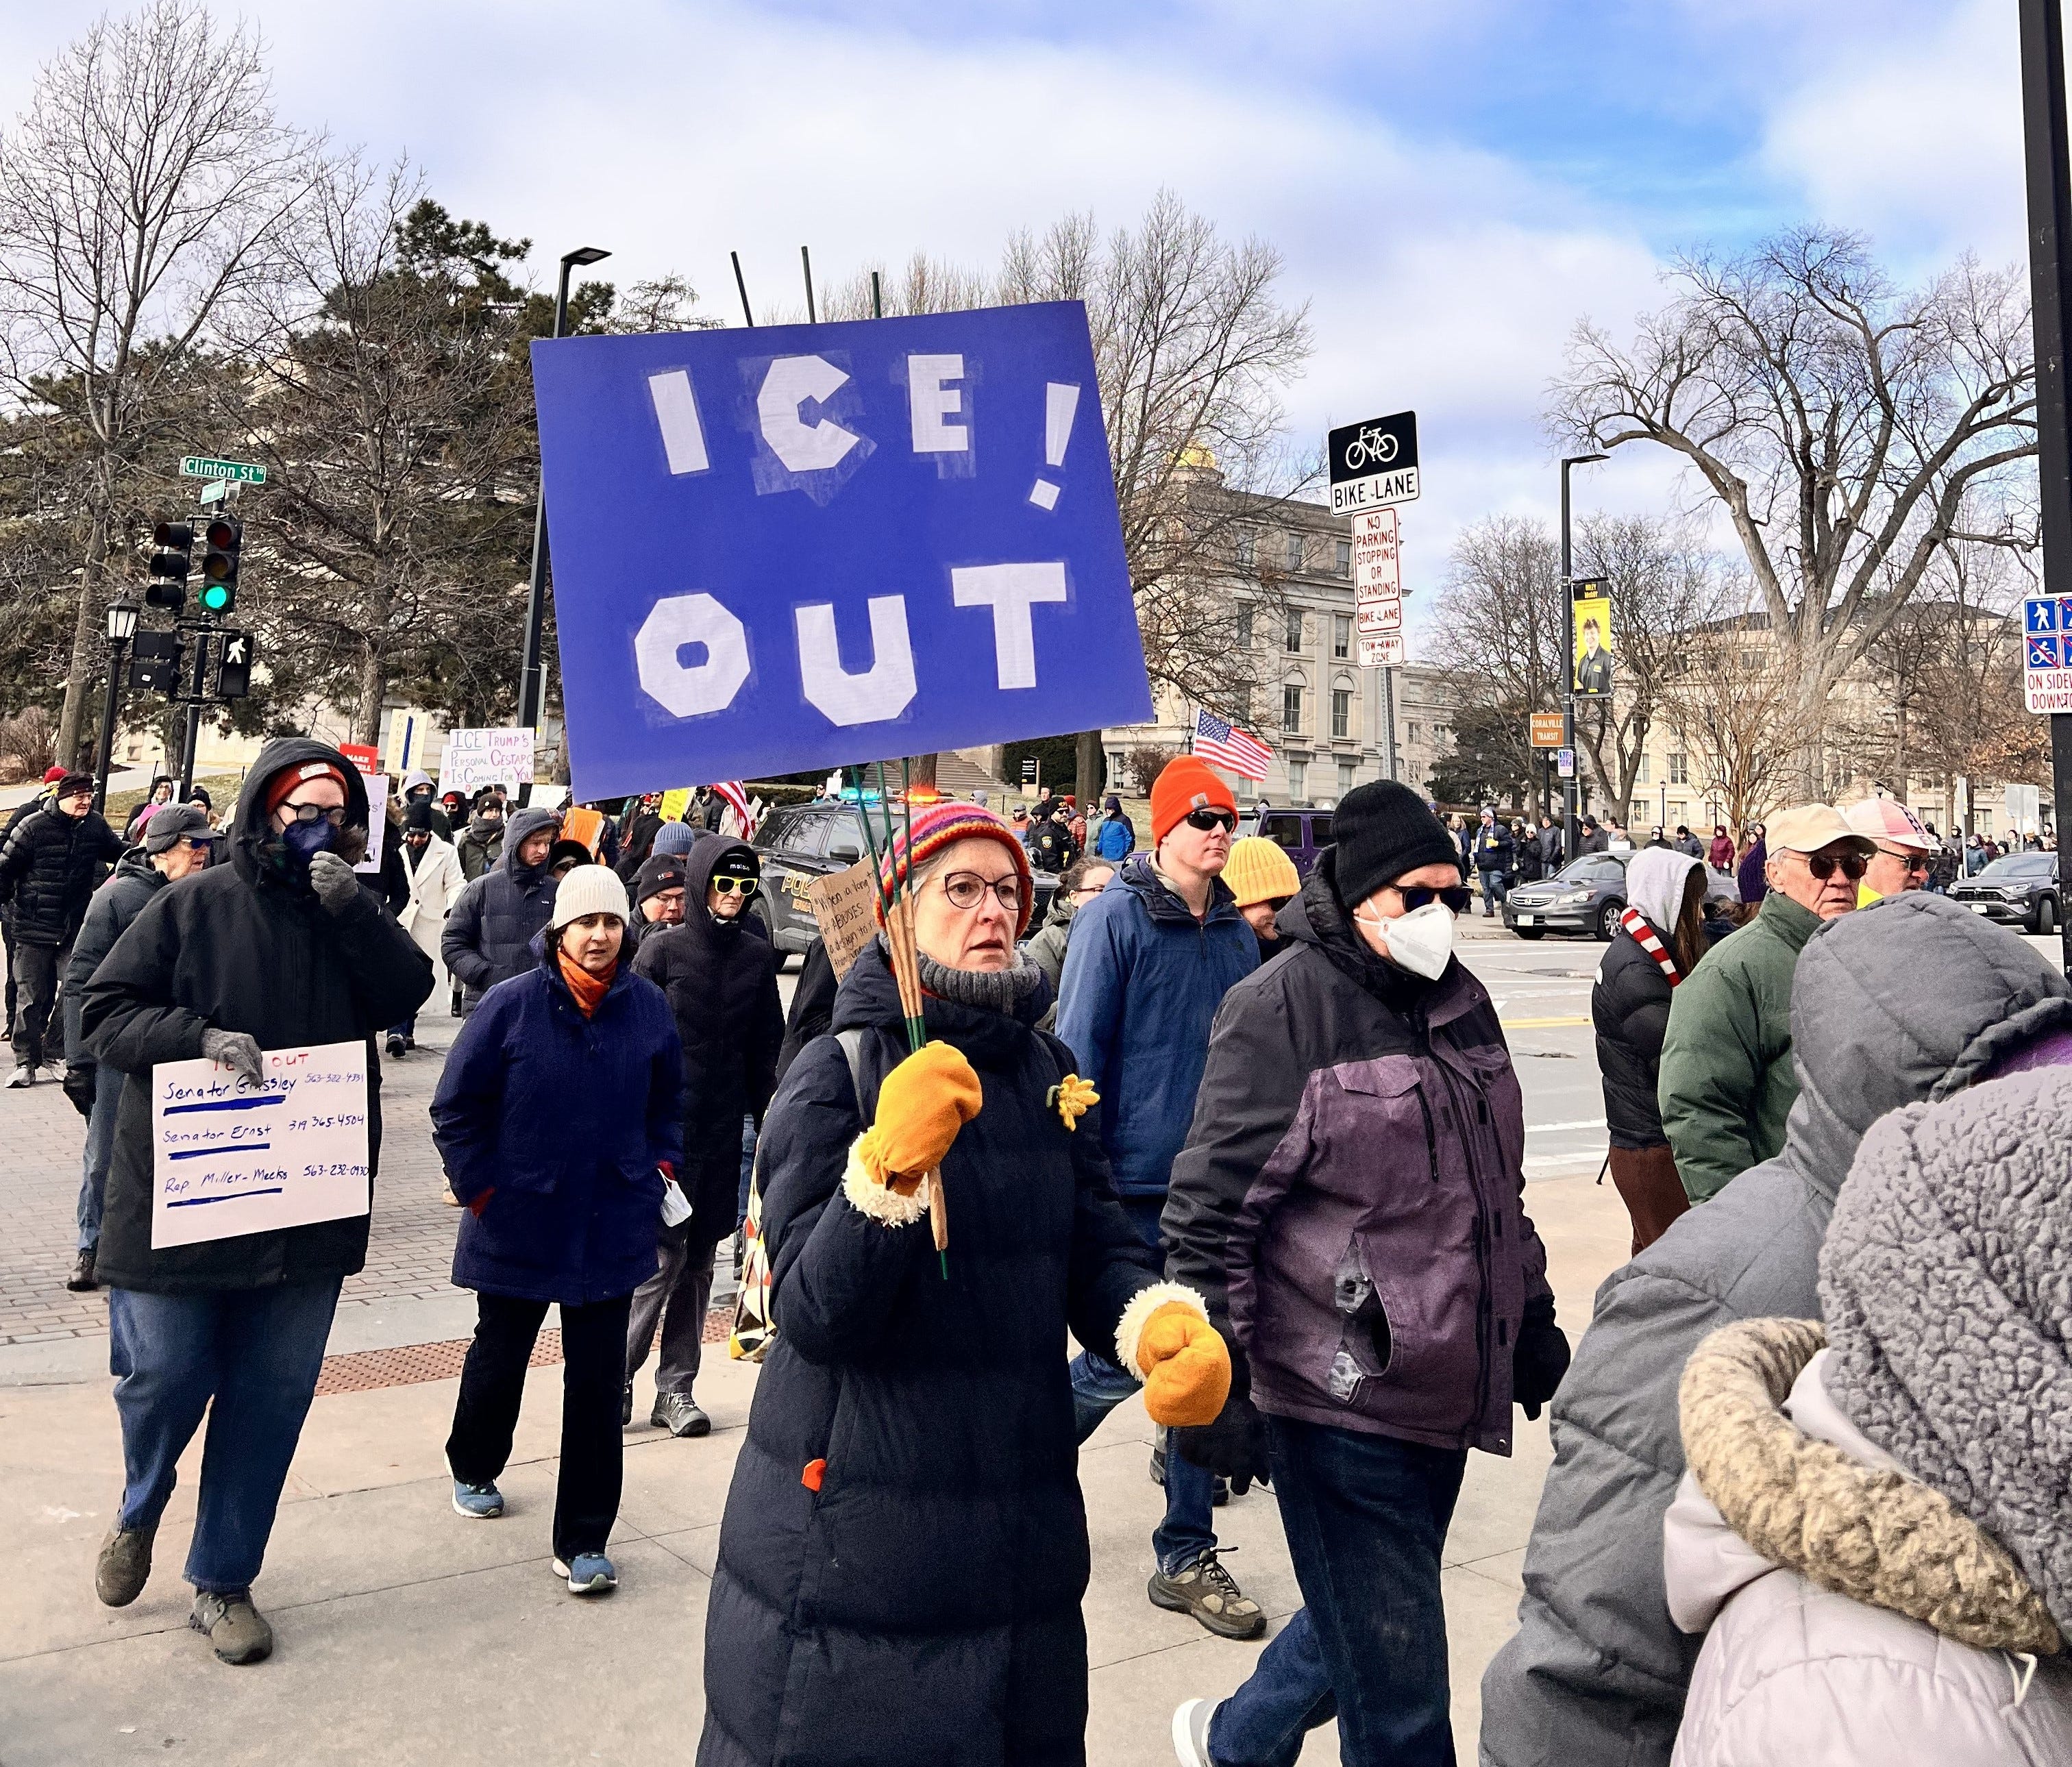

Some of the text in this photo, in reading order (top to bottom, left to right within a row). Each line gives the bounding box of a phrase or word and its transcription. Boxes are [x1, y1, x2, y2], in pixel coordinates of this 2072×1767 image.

[186, 459, 236, 478] Clinton
[239, 466, 254, 480] St
[1335, 473, 1415, 508] BIKE LANE
[1367, 515, 1381, 530] NO
[1356, 530, 1394, 548] PARKING
[1357, 547, 1395, 565] STOPPING
[1371, 566, 1381, 579] OR
[1359, 581, 1396, 598] STANDING
[1359, 608, 1399, 624] BIKE LANE
[634, 563, 1067, 726] OUT
[1371, 652, 1390, 663] ZONE
[2028, 674, 2043, 690] ON
[1532, 719, 1563, 728] CORALVILLE
[1537, 731, 1559, 741] TRANSIT
[513, 766, 534, 781] YOU
[781, 869, 822, 900] POL
[214, 1053, 309, 1071] IC OUT
[162, 1081, 230, 1100] Senator
[236, 1073, 297, 1094] Gssley
[163, 1131, 225, 1143] Senator
[230, 1125, 272, 1139] Ernst
[312, 1113, 364, 1128] 365-4504
